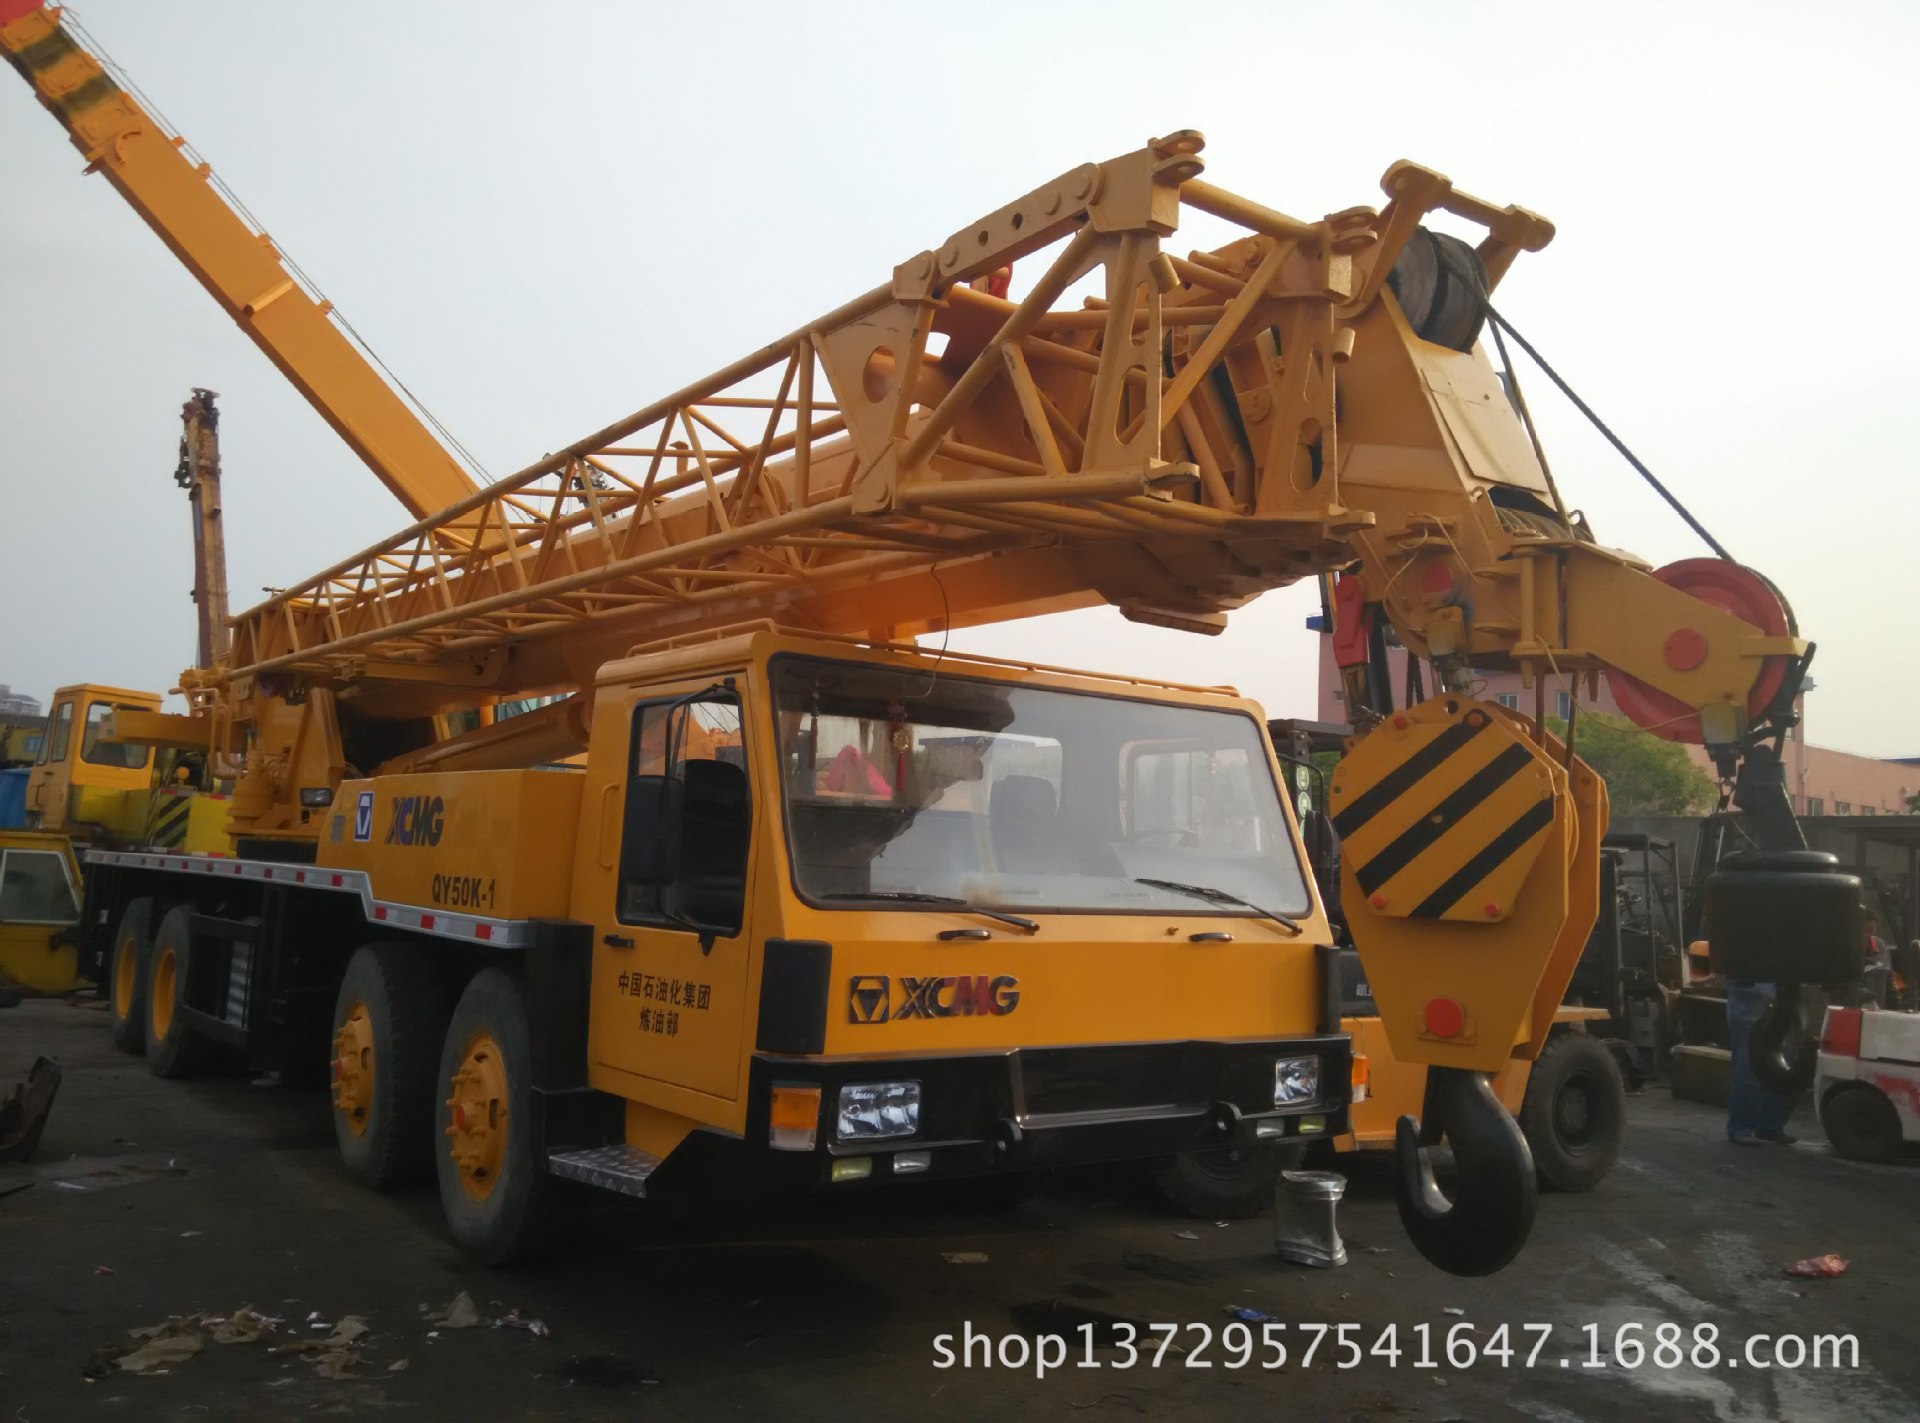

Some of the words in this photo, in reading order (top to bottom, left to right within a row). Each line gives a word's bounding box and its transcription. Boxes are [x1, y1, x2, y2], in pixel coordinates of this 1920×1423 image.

[384, 795, 445, 847] XCMG
[432, 874, 496, 909] QY50K-1
[618, 971, 711, 1011] 中国石油化集团
[893, 975, 1020, 1020] XCMG
